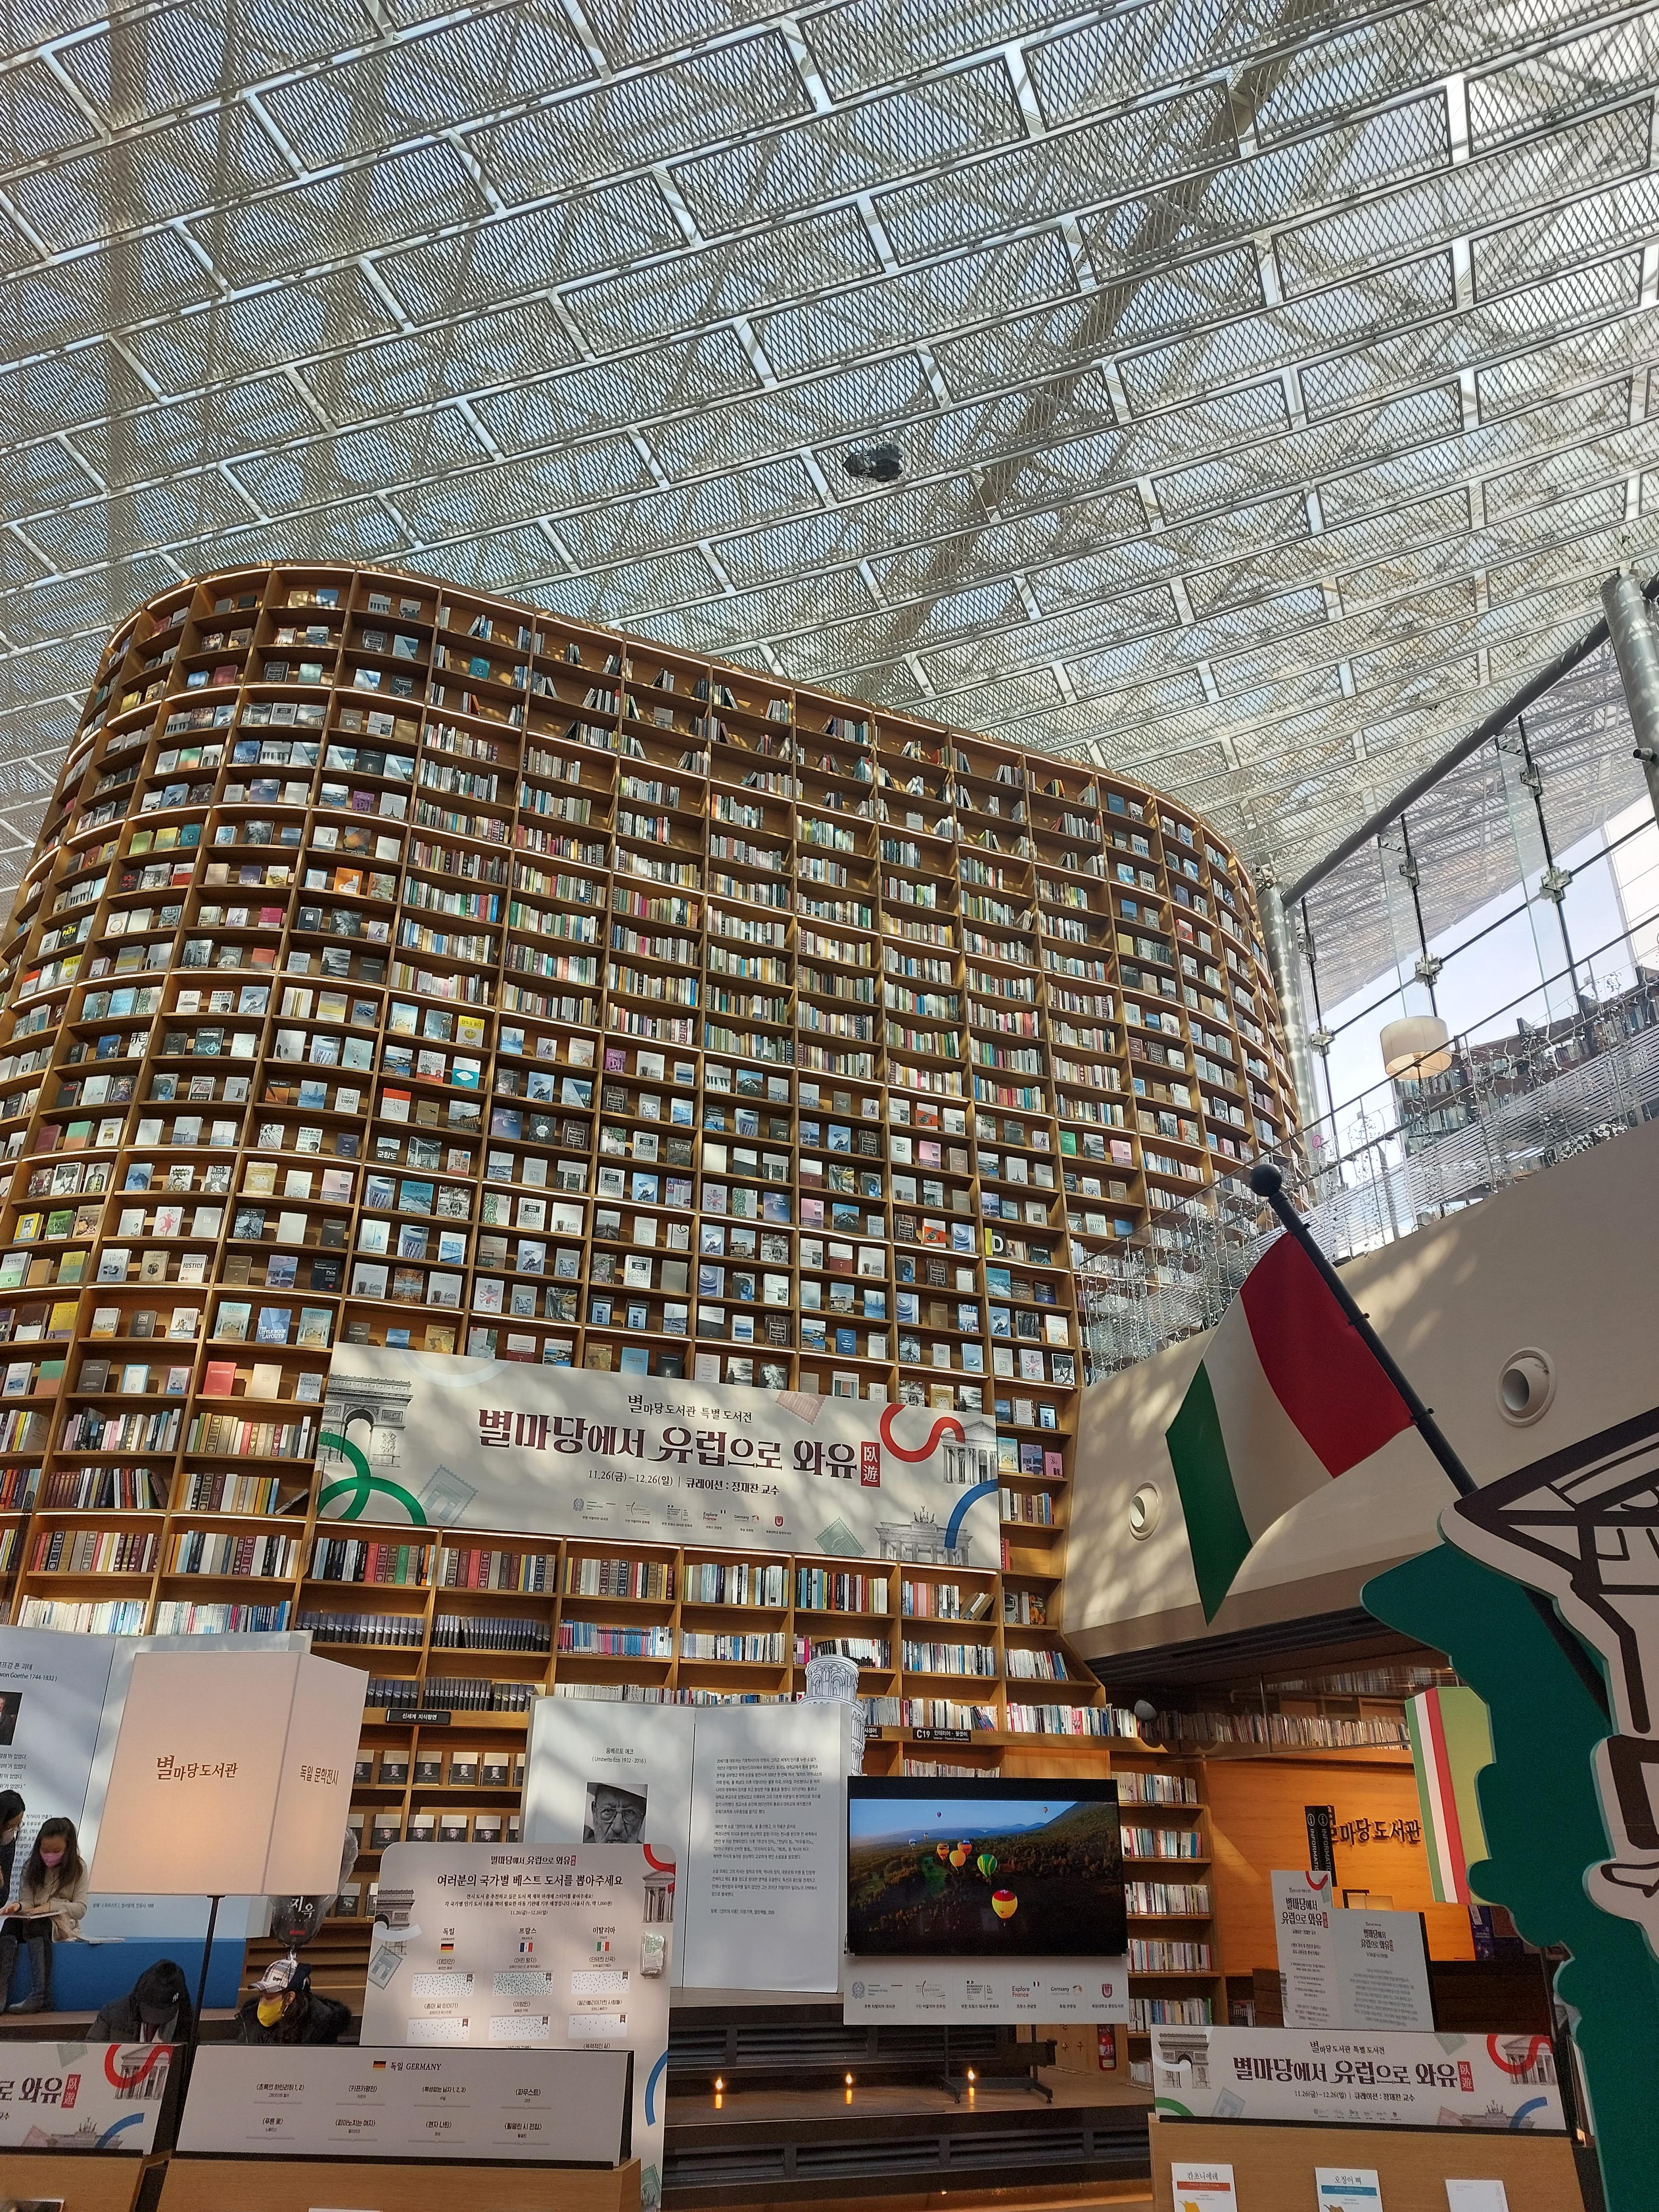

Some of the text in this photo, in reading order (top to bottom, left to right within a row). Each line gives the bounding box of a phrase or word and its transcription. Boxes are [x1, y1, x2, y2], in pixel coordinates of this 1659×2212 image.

[62, 927, 76, 936] PATH
[378, 1150, 397, 1160] 군함도
[700, 1407, 720, 1419] 특별
[723, 1410, 752, 1423] 도서전
[479, 1409, 857, 1479] 별마당에서 유럽으로 와유
[863, 1445, 878, 1483] 臥遊
[686, 1479, 723, 1491] 큐레이션
[731, 1482, 759, 1494] 정재찬
[761, 1484, 780, 1496] 교수
[917, 1729, 930, 1738] C19
[300, 1765, 339, 1786] 독일 문학전시
[525, 1856, 554, 1865] 유럽으로
[556, 1856, 571, 1865] 와유
[437, 1874, 623, 1887] 여러분의 국가별 베스트 도서를 뽑아주세요
[291, 1896, 316, 1919] 지옥
[1286, 1897, 1318, 1911] 별마당에서
[1281, 1912, 1323, 1926] 유럽으로 와유
[593, 1926, 616, 1935] 이탈리아
[1353, 2045, 1366, 2054] 특별
[1367, 2046, 1385, 2055] 도서전
[390, 2062, 442, 2071] 독일 GERMANY
[1233, 2057, 1458, 2088] 별마당에서 유럽으로 와유
[19, 2077, 63, 2104] 와유
[1403, 2094, 1415, 2102] 교수
[1187, 2171, 1218, 2181] 칸초니에레
[1334, 2176, 1354, 2185] 오징어
